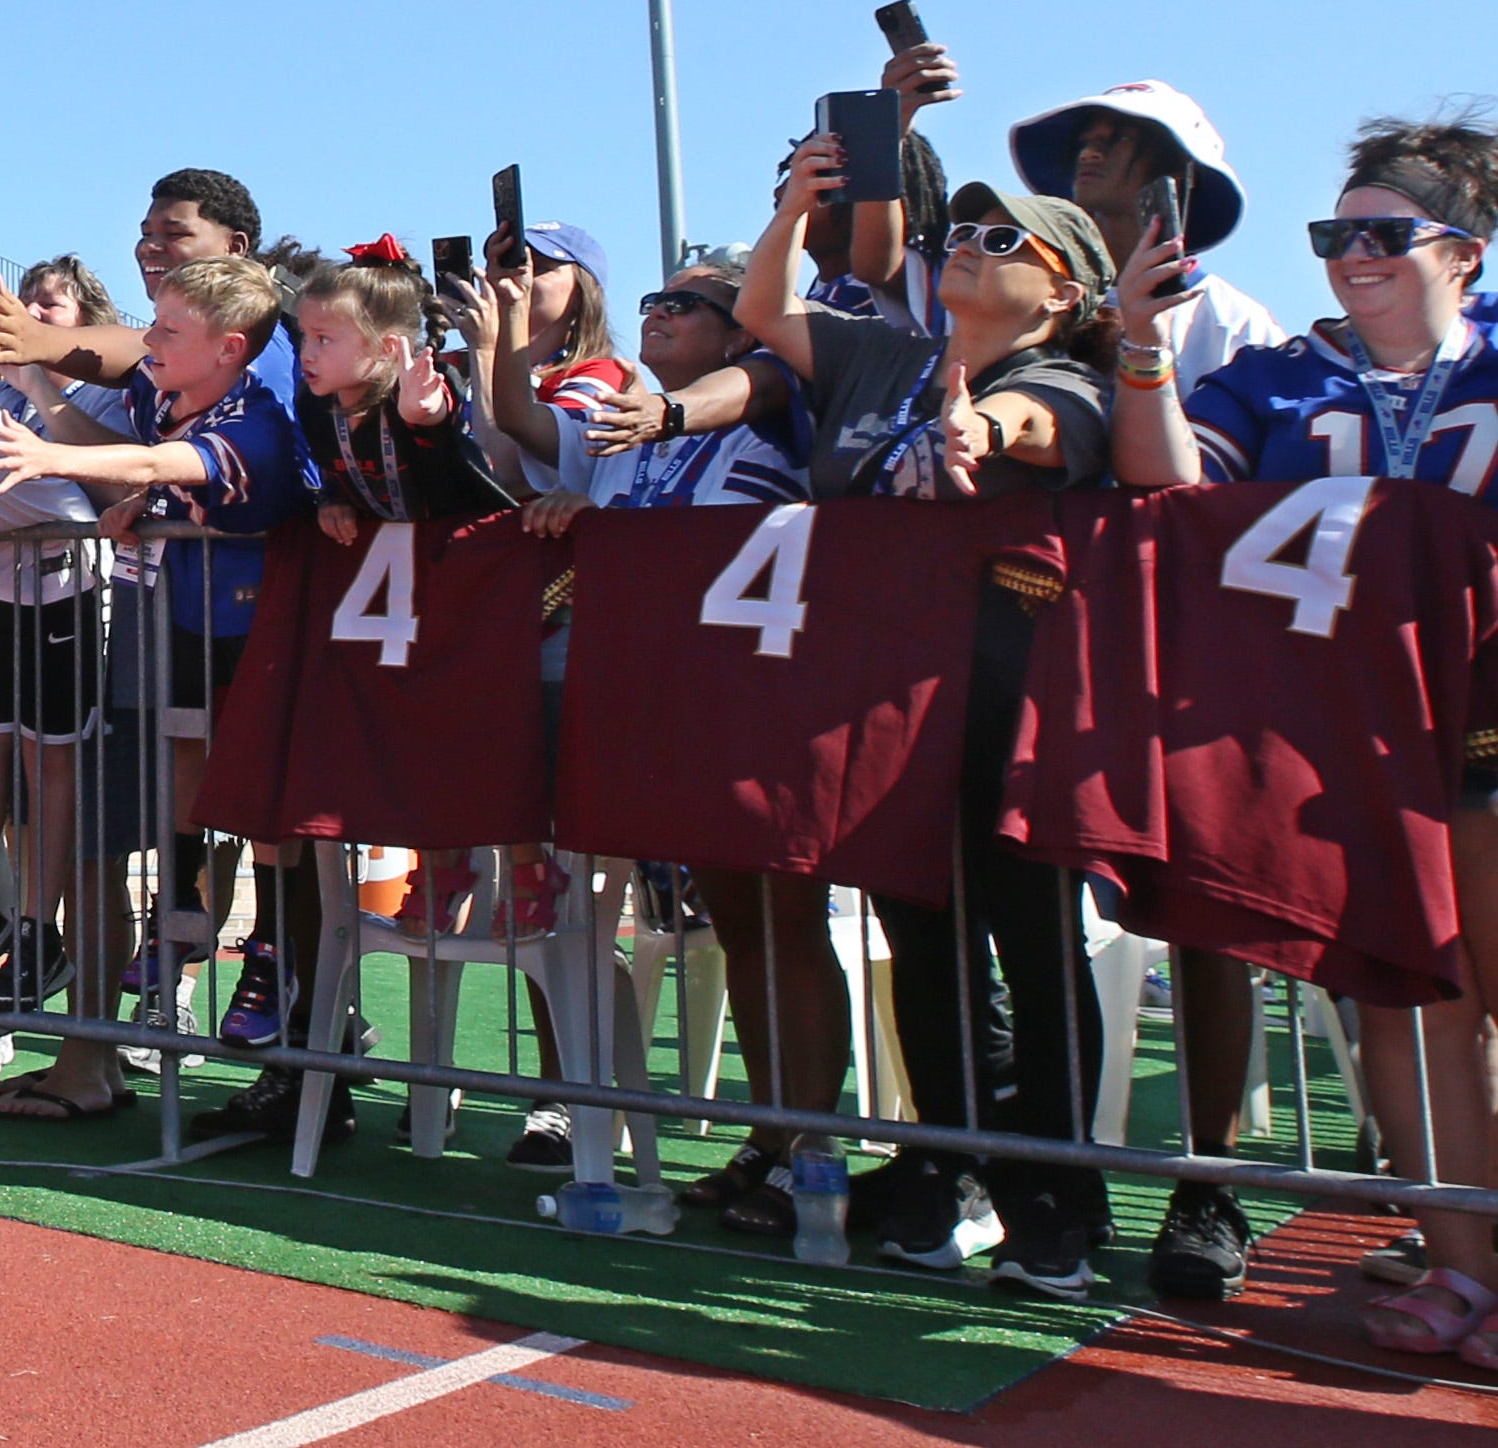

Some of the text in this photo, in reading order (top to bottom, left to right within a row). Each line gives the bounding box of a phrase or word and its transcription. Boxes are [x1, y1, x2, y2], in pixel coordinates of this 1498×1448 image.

[884, 442, 909, 472] BILLS
[897, 397, 913, 425] BILLS
[1308, 400, 1498, 497] 17
[330, 521, 420, 668] 4
[699, 503, 819, 659] 4
[1219, 475, 1380, 641] 4
